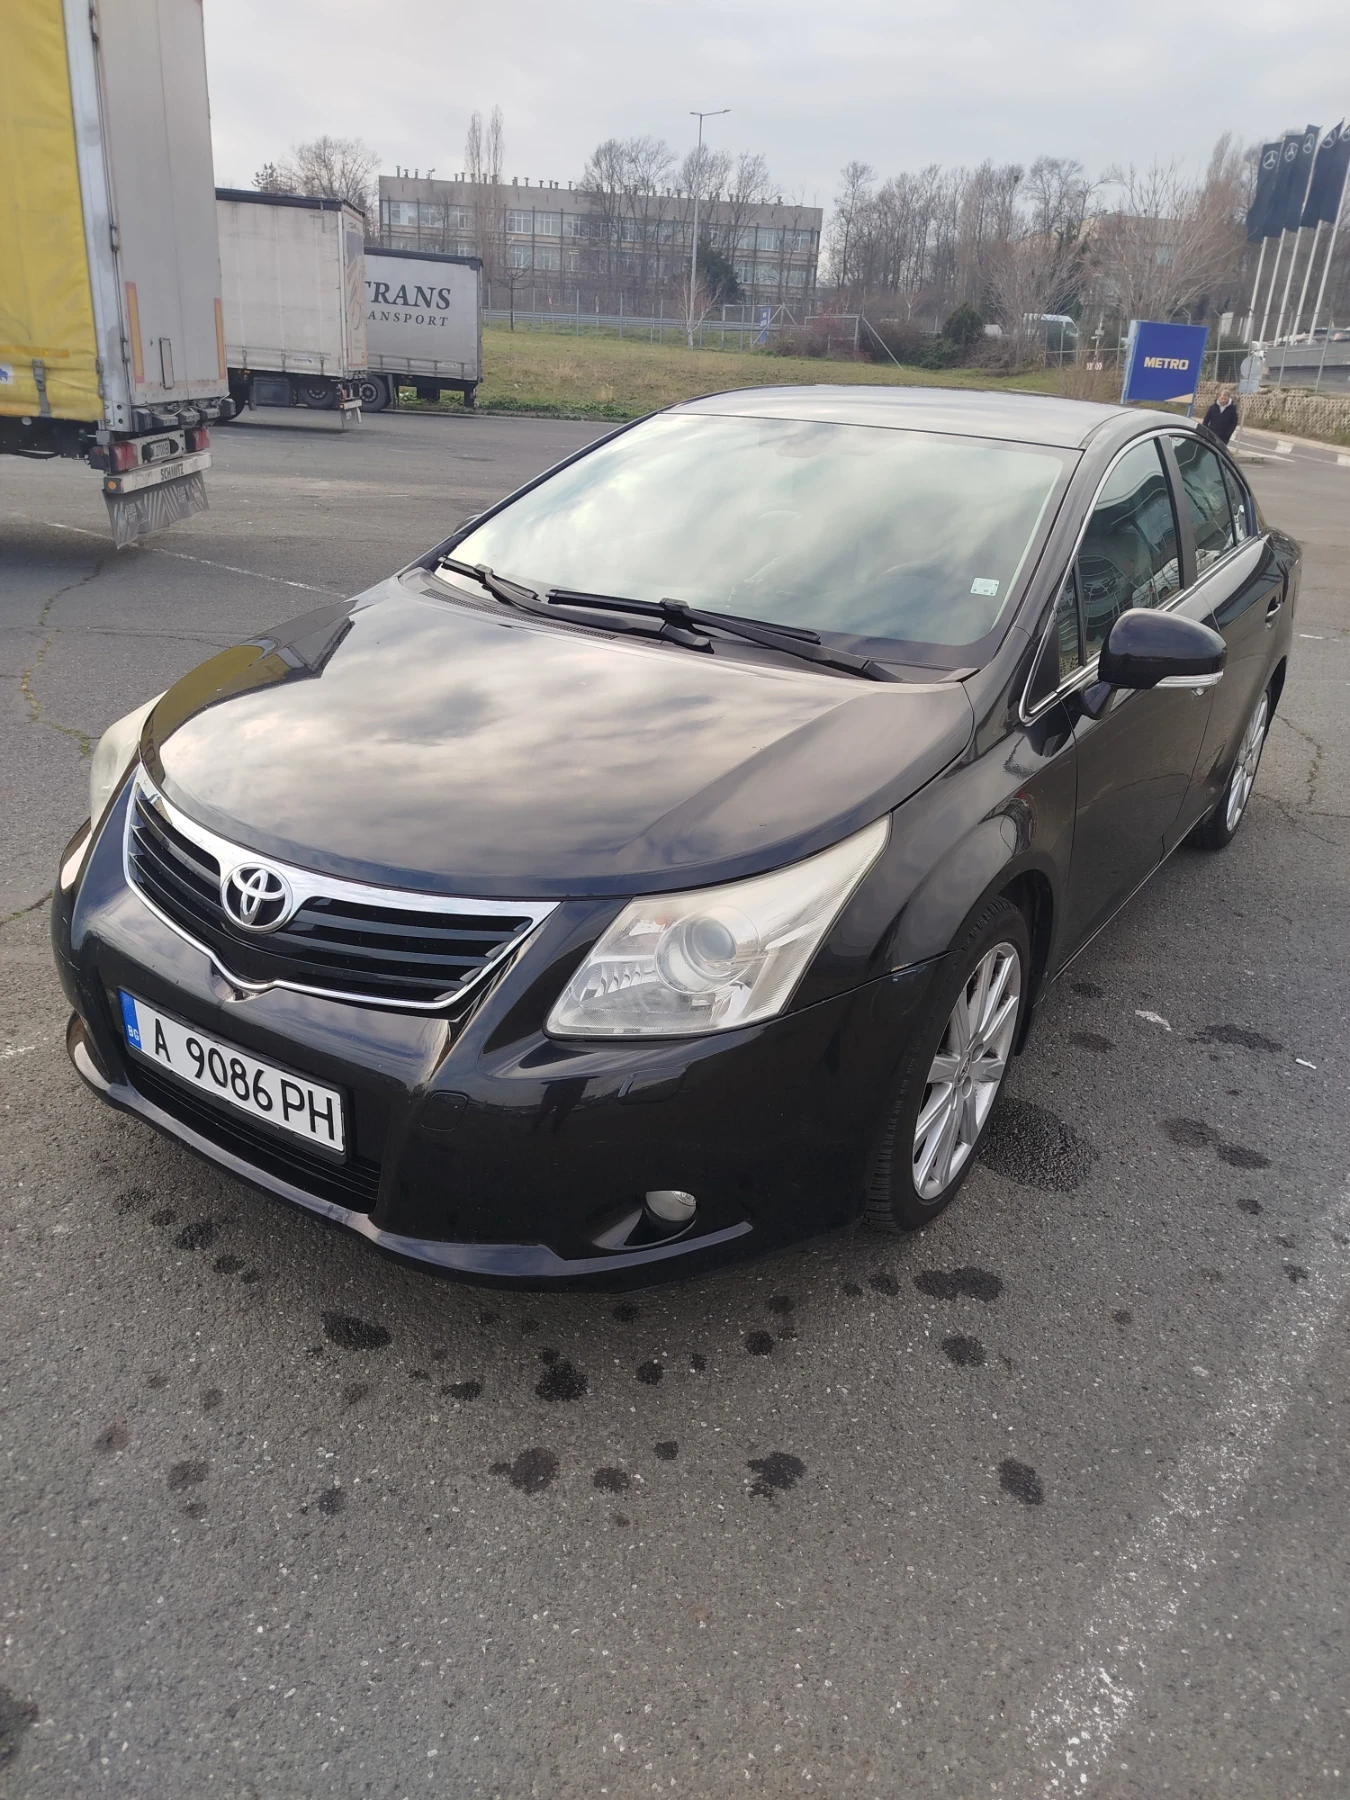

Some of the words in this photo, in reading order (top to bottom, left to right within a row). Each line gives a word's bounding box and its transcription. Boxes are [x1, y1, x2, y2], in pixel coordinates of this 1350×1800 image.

[367, 310, 448, 327] ANSPORT
[1143, 356, 1189, 371] METRO
[127, 1024, 140, 1042] BG
[155, 1017, 172, 1064] A
[185, 1037, 274, 1112] 9086
[280, 1078, 335, 1141] PH
